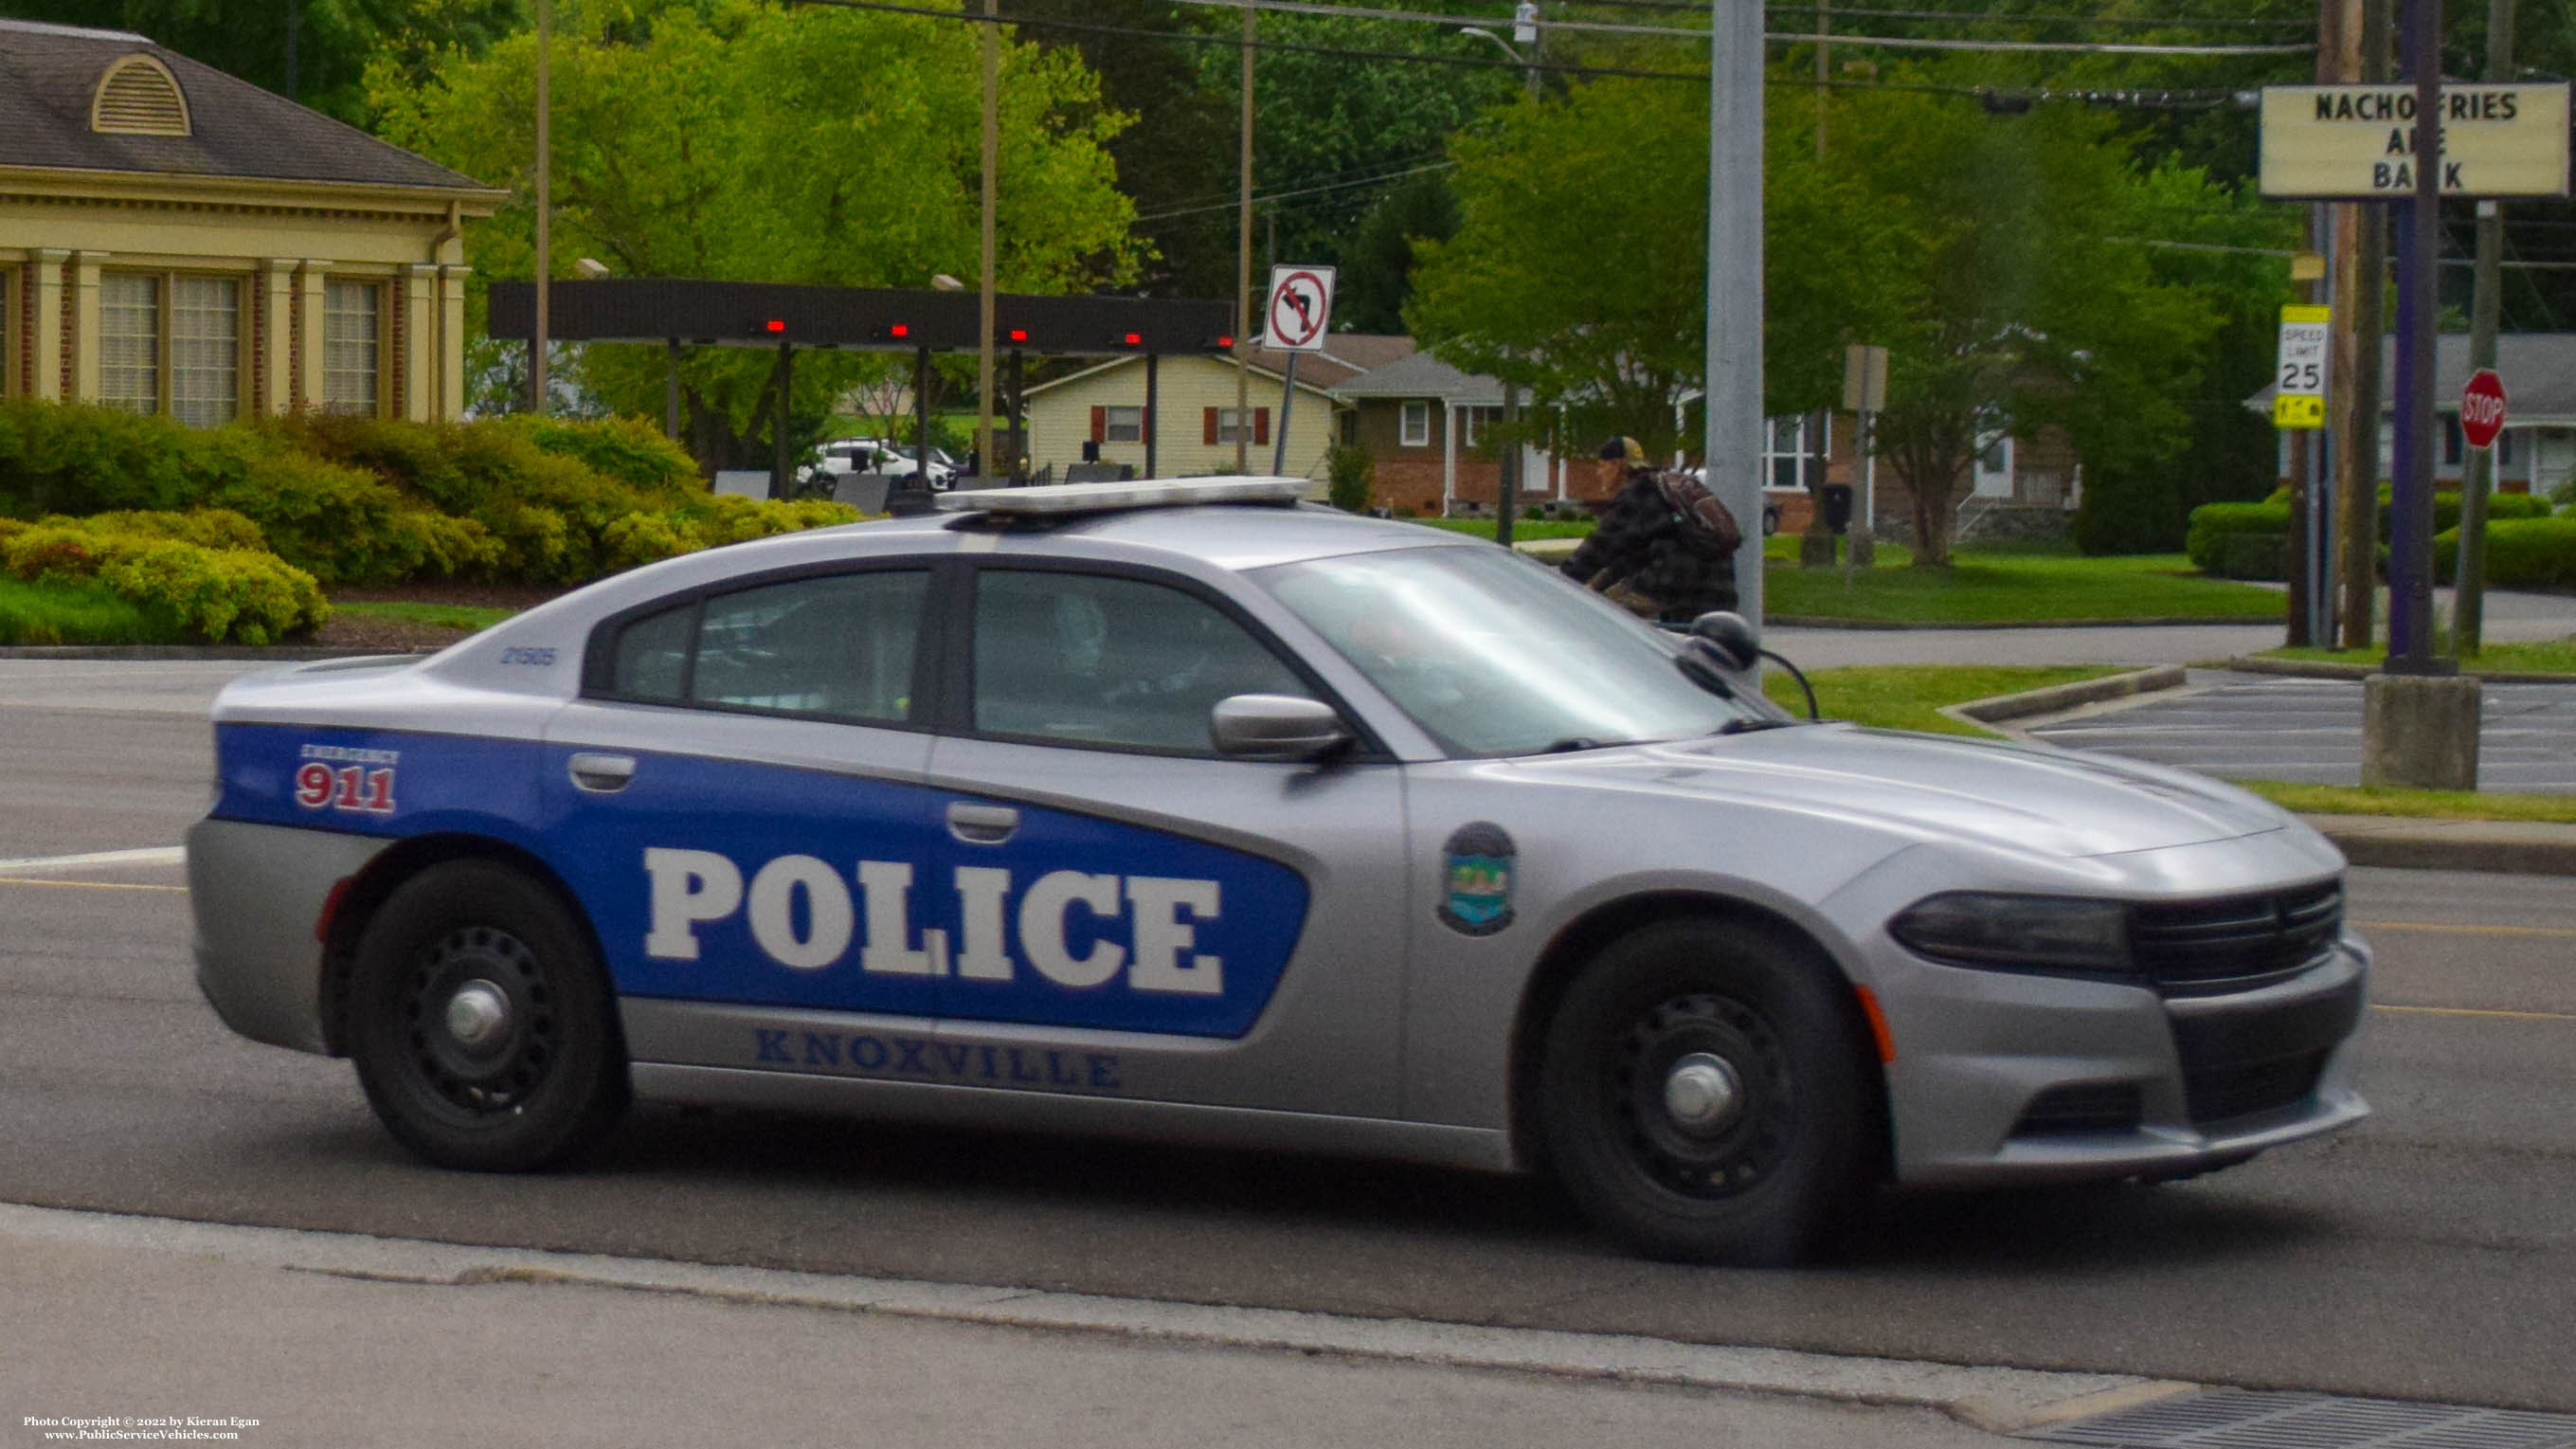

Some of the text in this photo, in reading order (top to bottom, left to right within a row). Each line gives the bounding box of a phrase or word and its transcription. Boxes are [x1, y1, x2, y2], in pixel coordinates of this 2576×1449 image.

[2316, 93, 2416, 120] NACHO
[2373, 162, 2462, 189] BAK
[2284, 329, 2324, 341] SPEED
[2288, 344, 2319, 357] LIMIT
[2282, 363, 2320, 389] 25
[2463, 391, 2503, 425] STOP
[295, 762, 396, 813] 911
[644, 847, 1223, 994] POLICE
[755, 1028, 1122, 1088] KNOXVILLE
